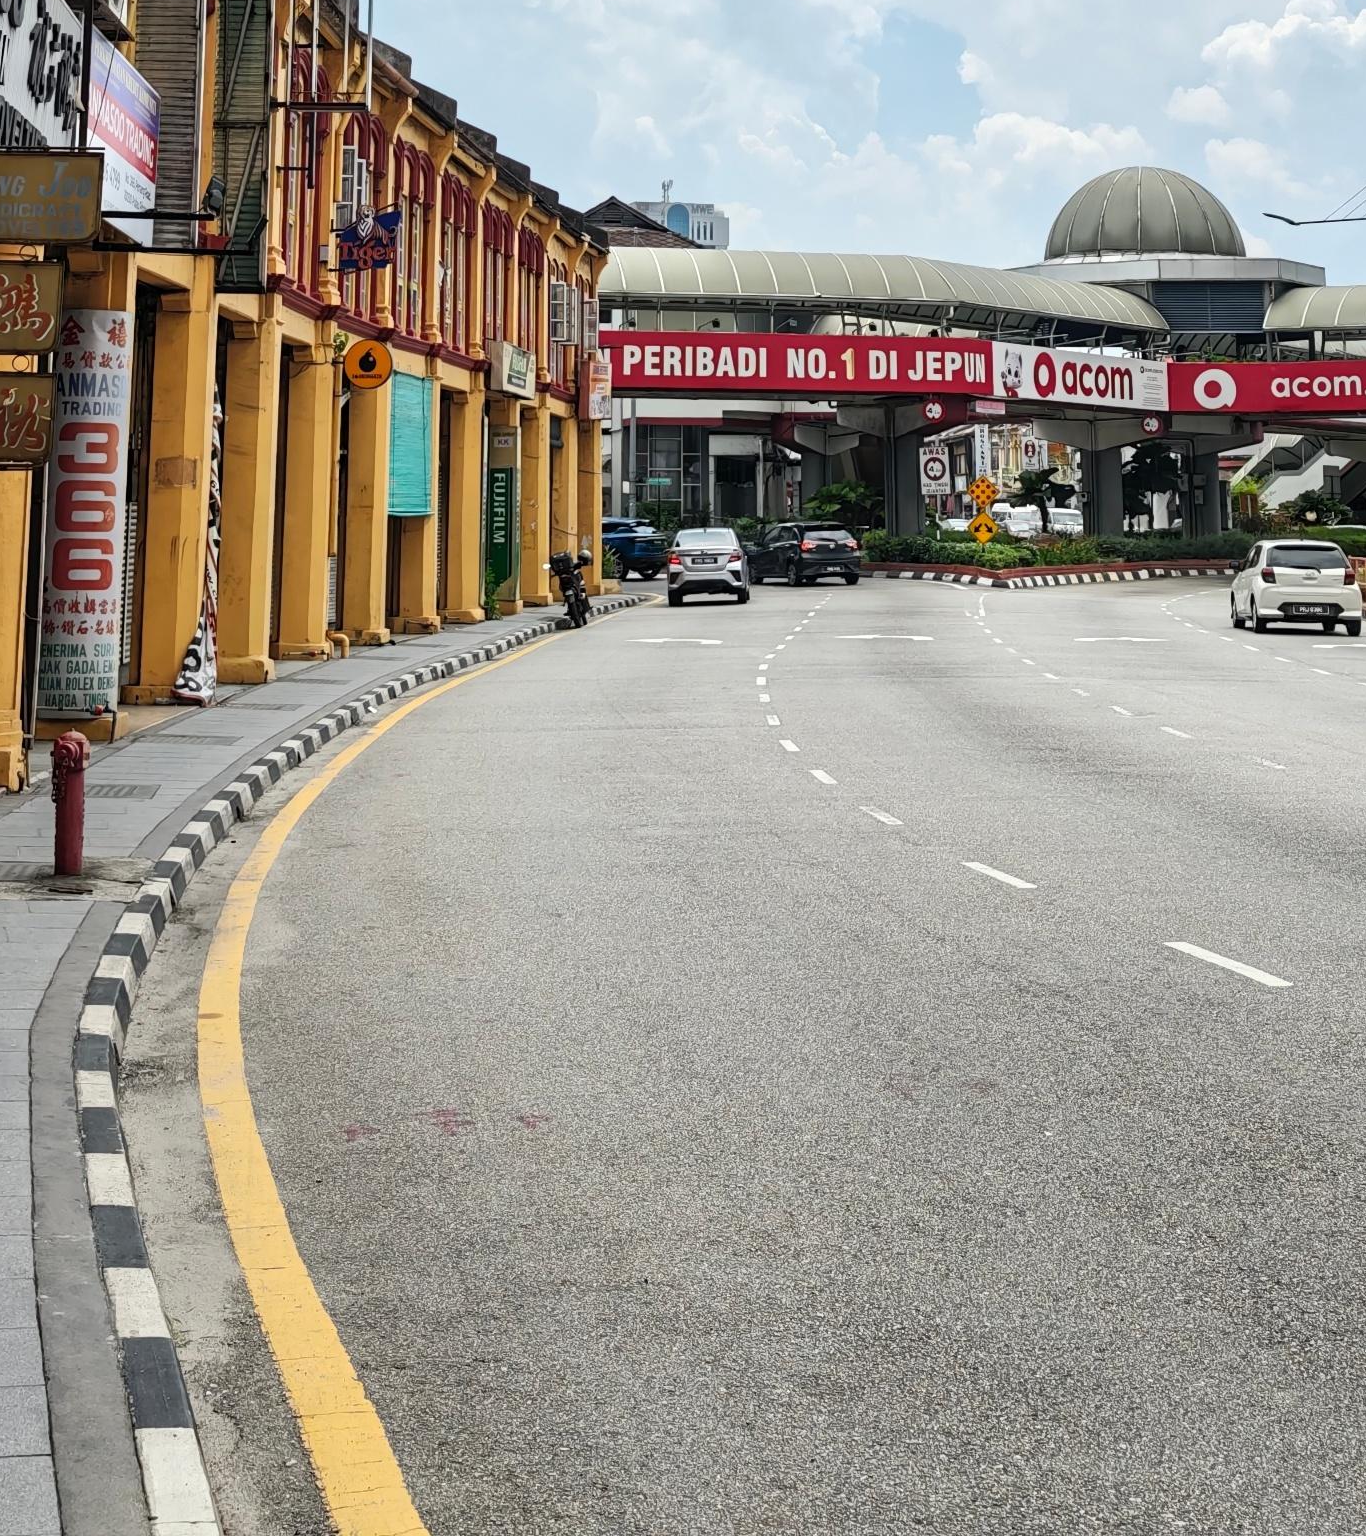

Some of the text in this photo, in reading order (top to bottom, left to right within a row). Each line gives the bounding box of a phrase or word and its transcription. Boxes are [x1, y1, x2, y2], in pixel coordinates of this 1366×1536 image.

[126, 121, 154, 168] TRADING
[340, 242, 396, 268] Tiger
[61, 315, 127, 348] 金禧
[56, 350, 128, 369] 易貸款公
[623, 345, 767, 378] PERIBADI
[787, 348, 855, 380] NO.1
[869, 350, 898, 380] DI
[908, 350, 985, 383] JEPUN
[57, 373, 126, 398] ANMAS
[1062, 363, 1133, 401] acom
[62, 401, 122, 416] TRADING
[923, 448, 945, 456] AWAS
[52, 422, 119, 591] 366
[493, 473, 506, 543] FUJIFILM
[41, 644, 114, 657] ENERIMA SUR
[40, 660, 60, 674] JAK
[66, 677, 94, 690] ROLEX
[45, 693, 75, 707] HARGA
